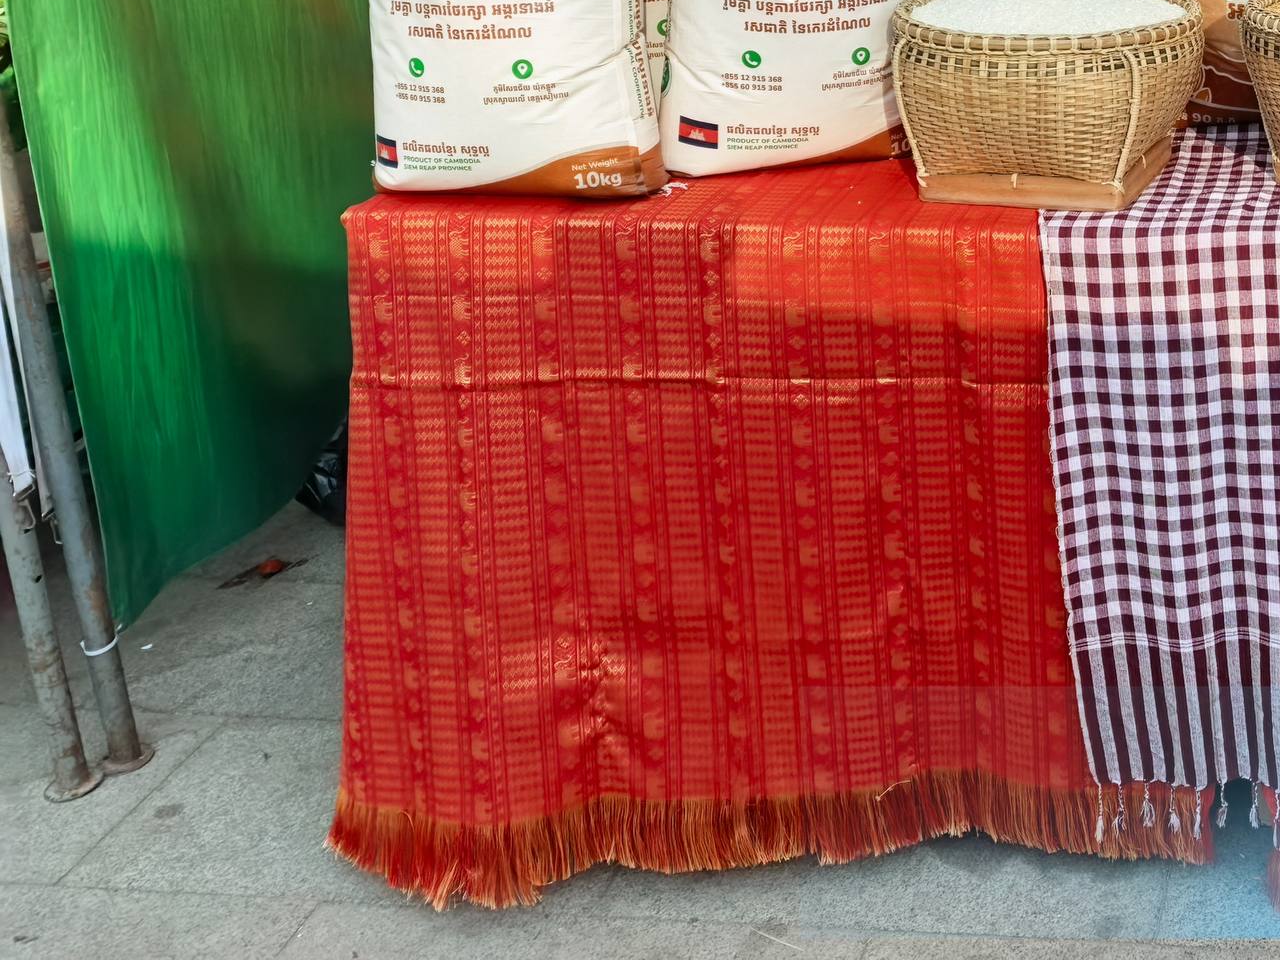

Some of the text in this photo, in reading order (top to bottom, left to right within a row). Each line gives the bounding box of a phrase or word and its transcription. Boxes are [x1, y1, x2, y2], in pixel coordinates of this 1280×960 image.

[721, 73, 783, 83] +855 12 915 368
[418, 85, 430, 93] 915
[431, 86, 445, 94] 368
[721, 82, 783, 92] +855 60 915 368
[410, 94, 418, 102] 60
[419, 95, 431, 103] 915
[432, 96, 446, 104] 368
[727, 137, 809, 145] PRODUCT OF CAMBODIA
[891, 138, 911, 155] 10
[403, 155, 432, 164] PRODUCT
[444, 157, 481, 165] CAMBODIA
[588, 157, 619, 169] Weight
[419, 164, 437, 172] REAP
[574, 171, 622, 189] 10kg
